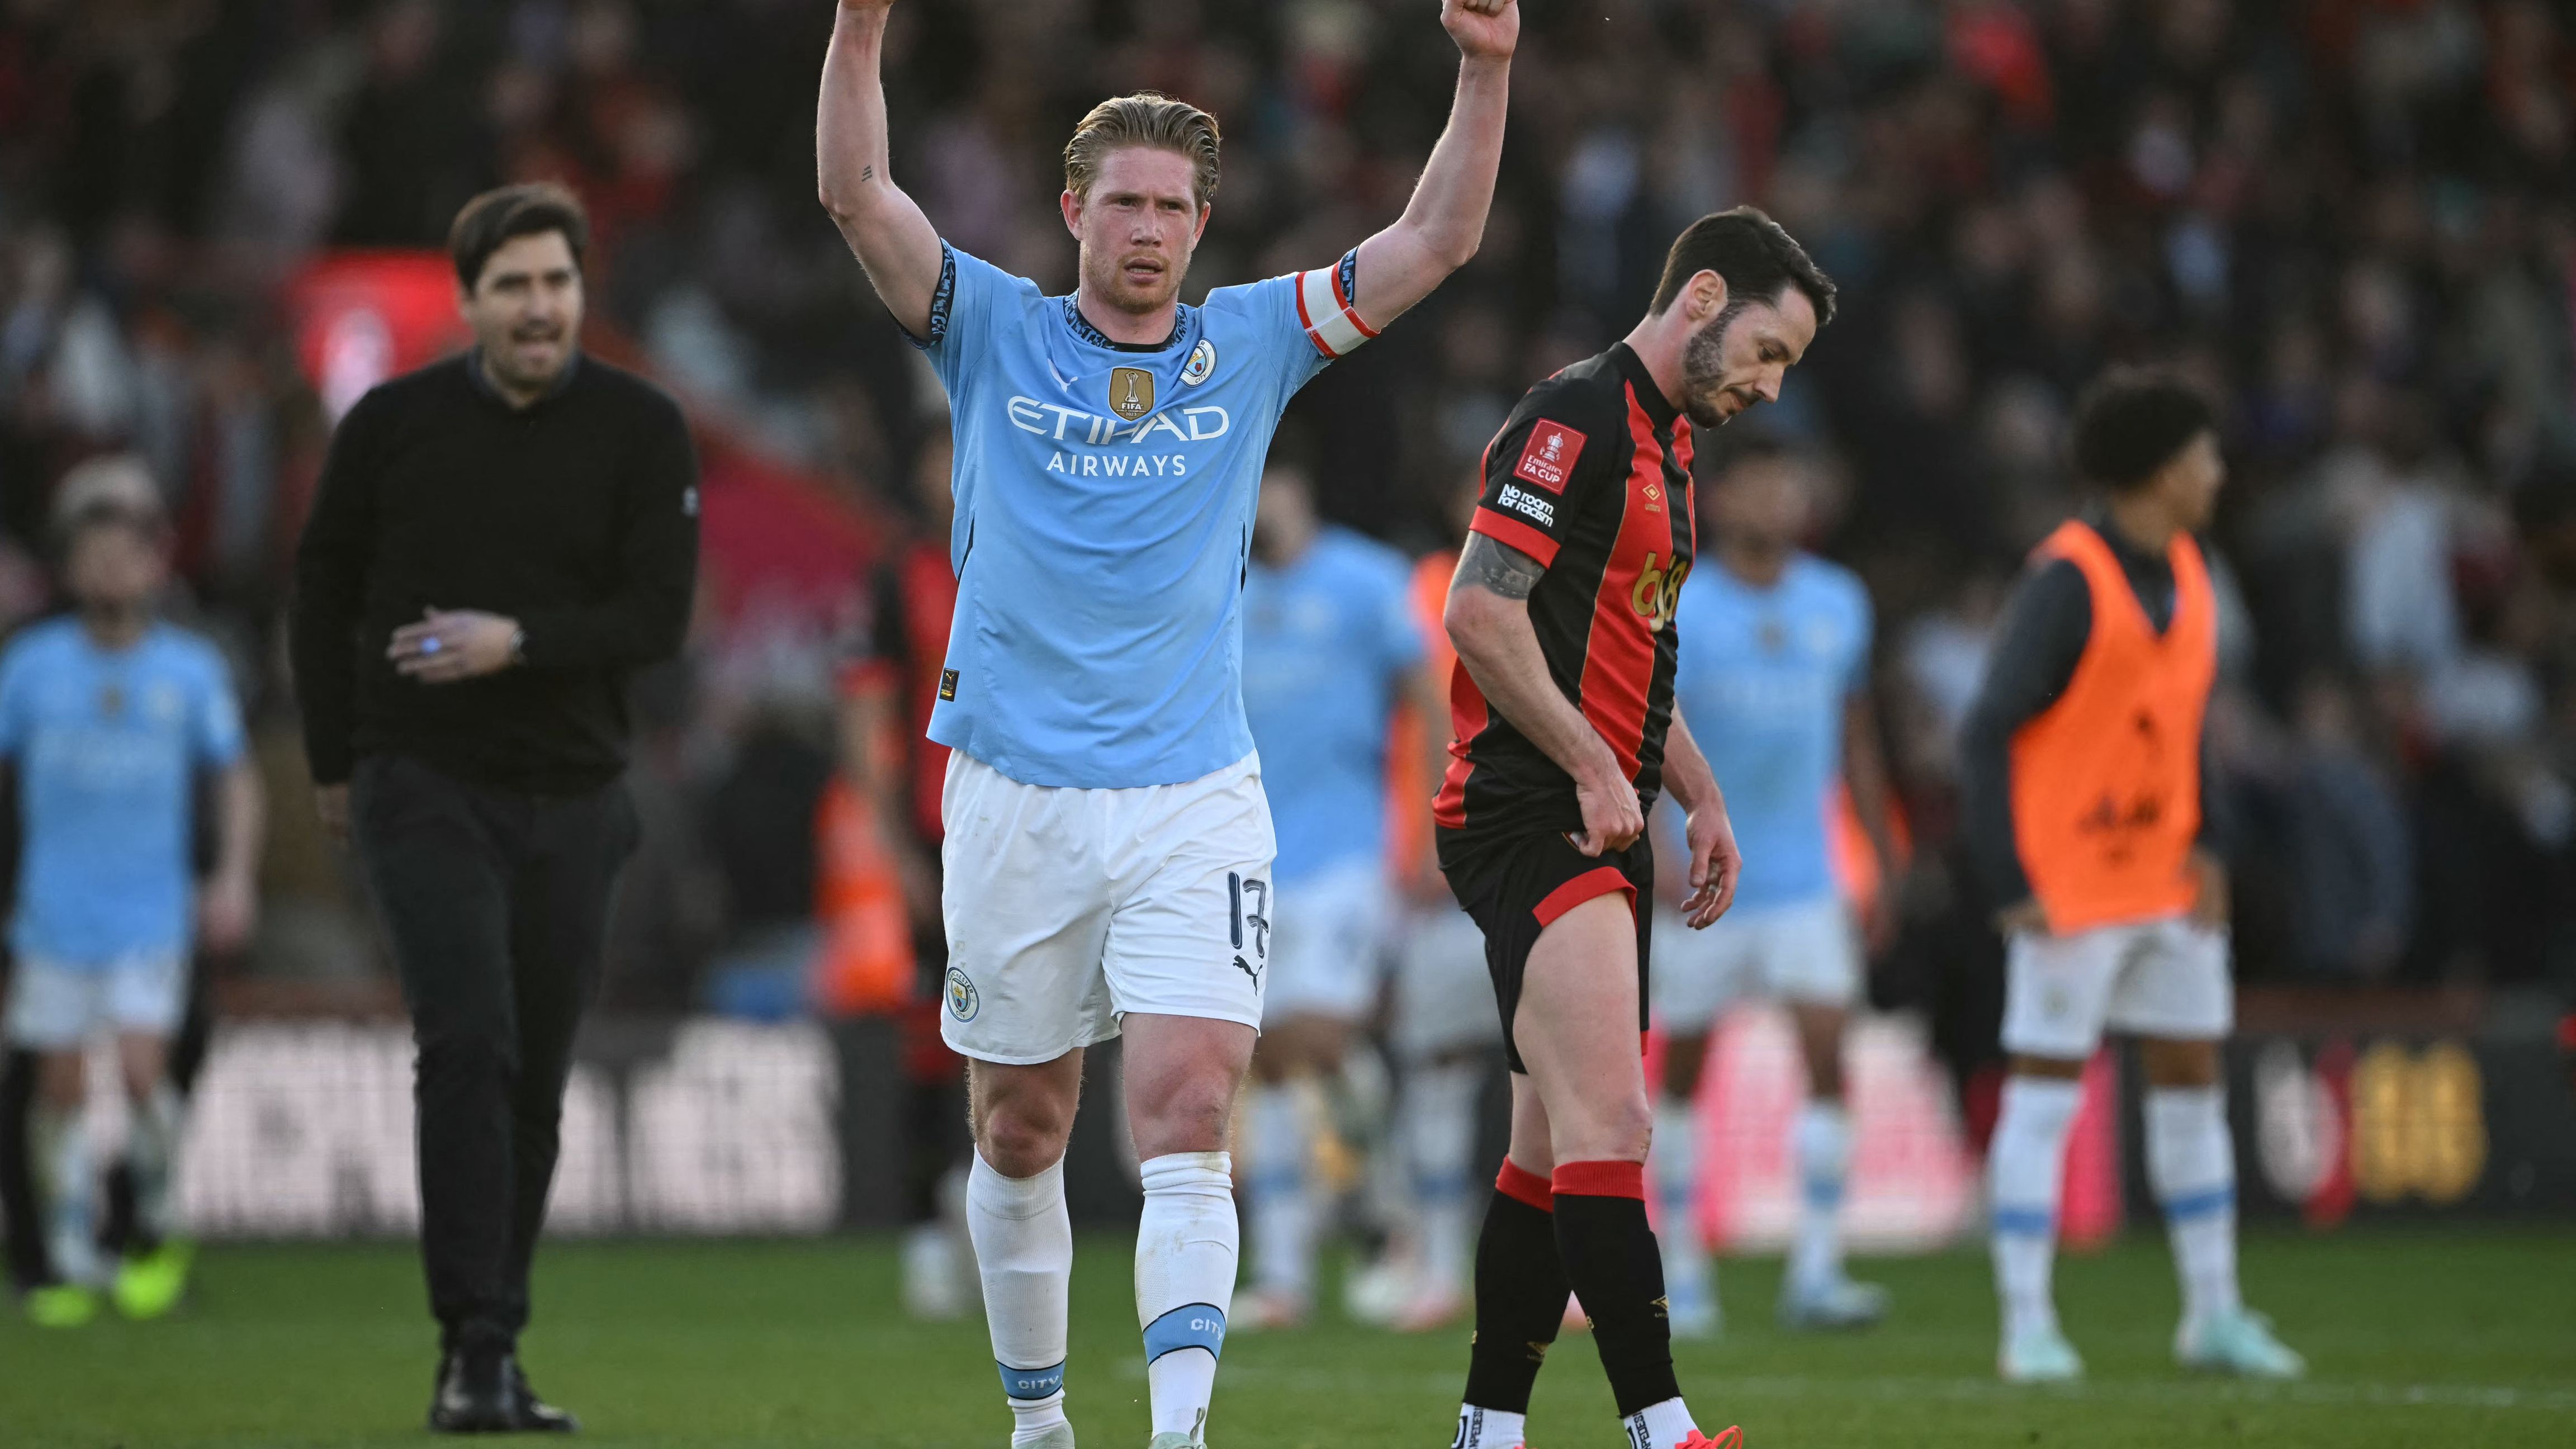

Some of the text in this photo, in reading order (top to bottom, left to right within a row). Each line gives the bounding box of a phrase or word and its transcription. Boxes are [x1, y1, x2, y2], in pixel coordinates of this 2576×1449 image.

[1195, 373, 1206, 383] CITY
[1007, 396, 1229, 444] ETIHAD
[1046, 452, 1186, 476] AIRWAYS
[1523, 463, 1560, 483] FA CUP
[1527, 455, 1562, 475] Emirates
[1498, 493, 1554, 527] for racism
[1501, 484, 1554, 515] No room
[1227, 870, 1269, 959] 17
[955, 1010, 965, 1019] CITY
[1191, 1318, 1223, 1341] CITY
[1018, 1375, 1059, 1389] CITY
